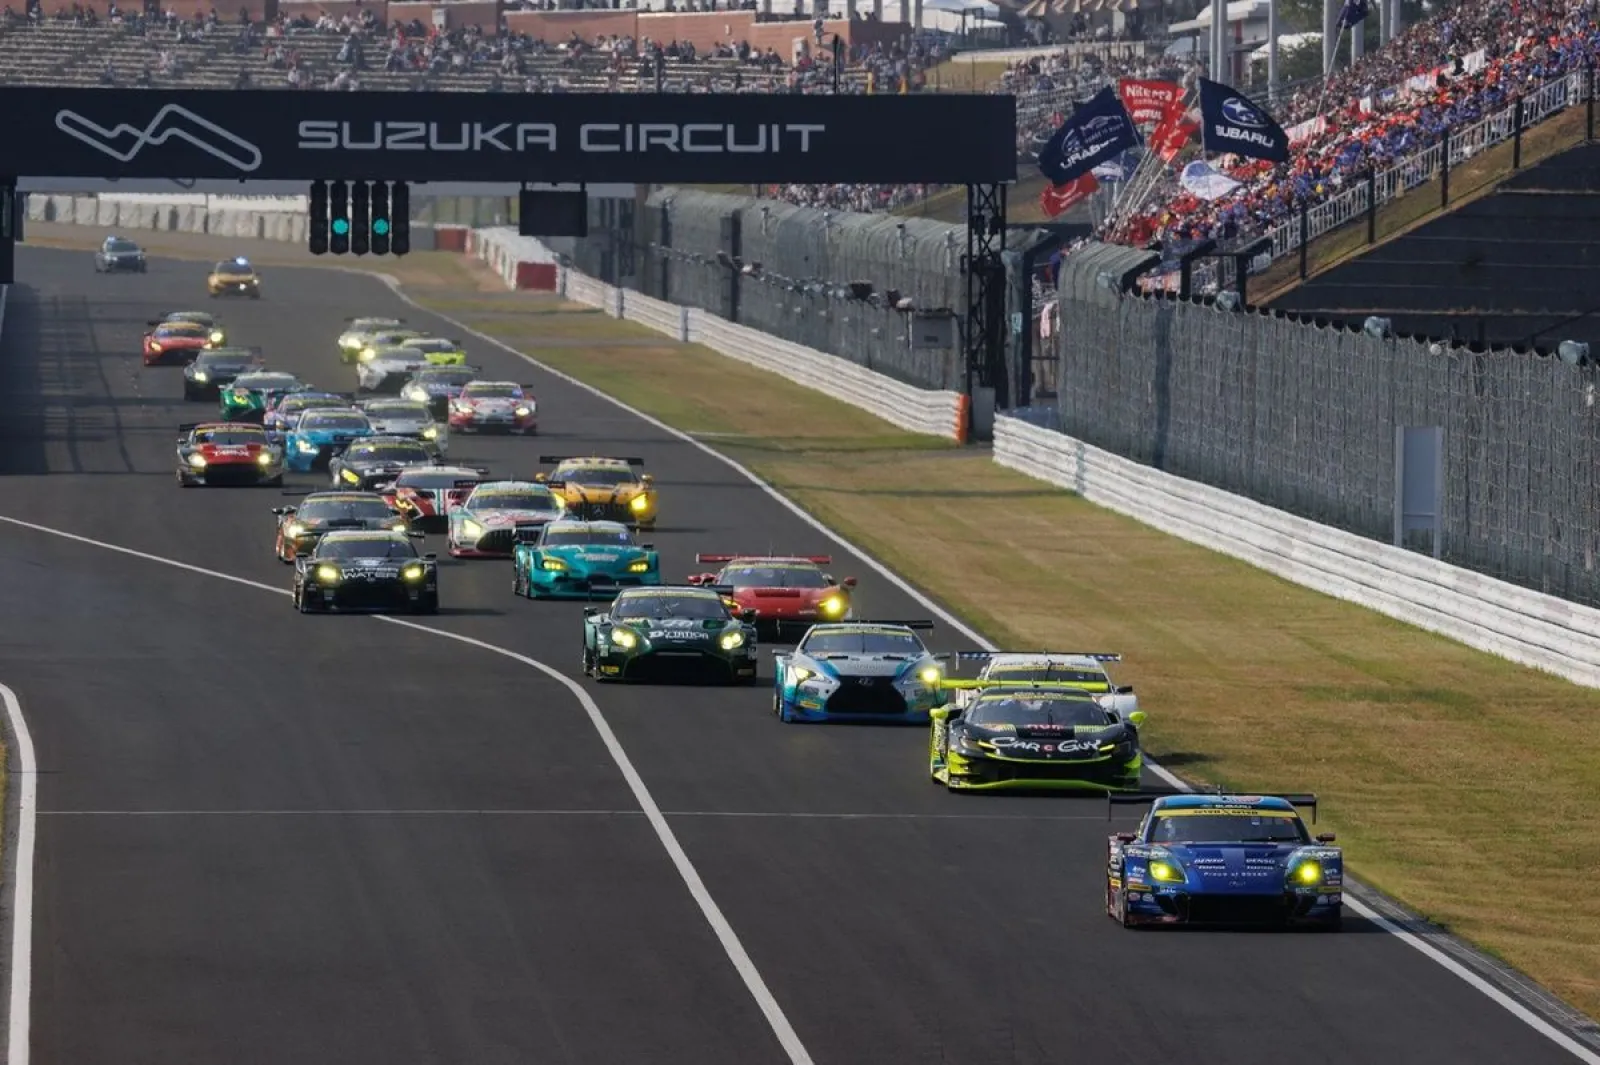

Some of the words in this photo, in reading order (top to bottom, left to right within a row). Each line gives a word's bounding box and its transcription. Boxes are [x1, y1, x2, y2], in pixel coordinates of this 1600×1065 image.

[298, 121, 557, 151] SUZUKA
[580, 123, 825, 152] CIRCUIT
[1215, 125, 1274, 148] SUBARU
